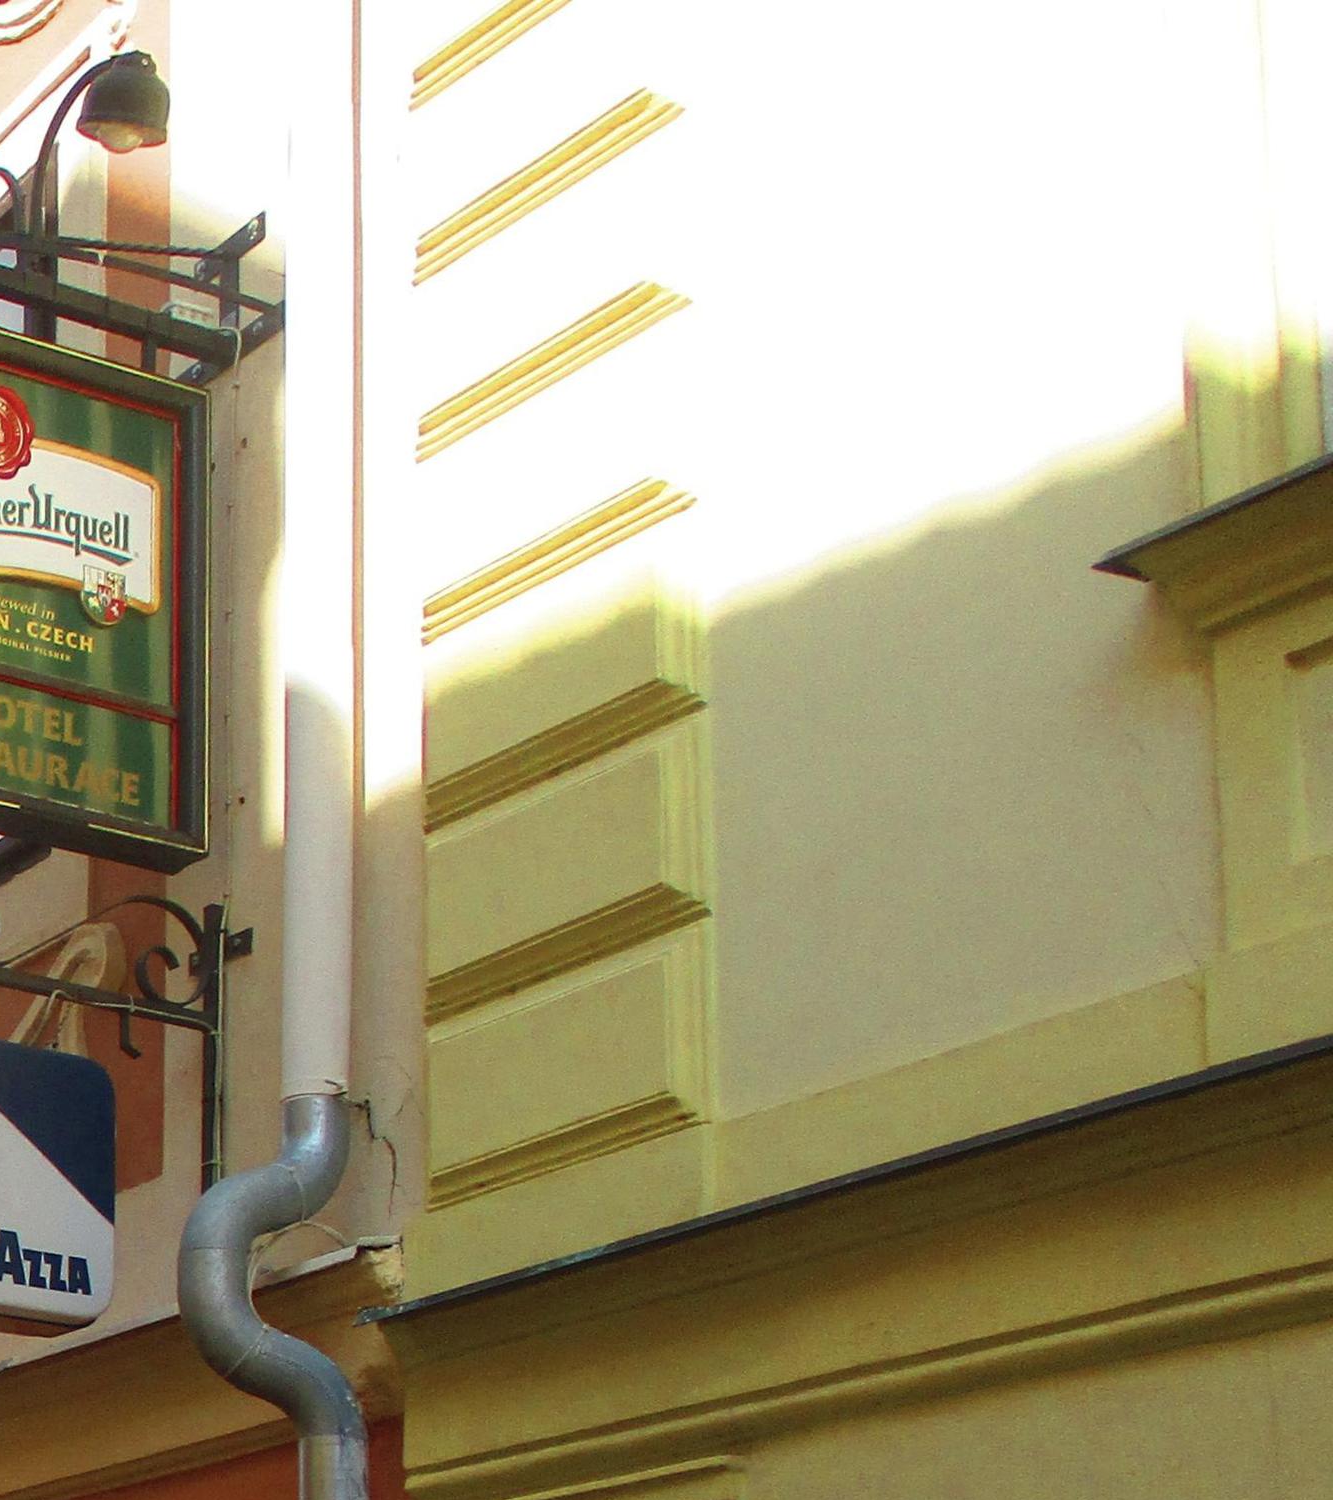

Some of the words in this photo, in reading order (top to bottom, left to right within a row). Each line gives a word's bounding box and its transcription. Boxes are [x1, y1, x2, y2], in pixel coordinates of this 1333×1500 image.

[28, 482, 131, 557] Urquell
[40, 604, 56, 622] in
[25, 620, 95, 654] CZECH
[33, 645, 73, 663] PILSNER
